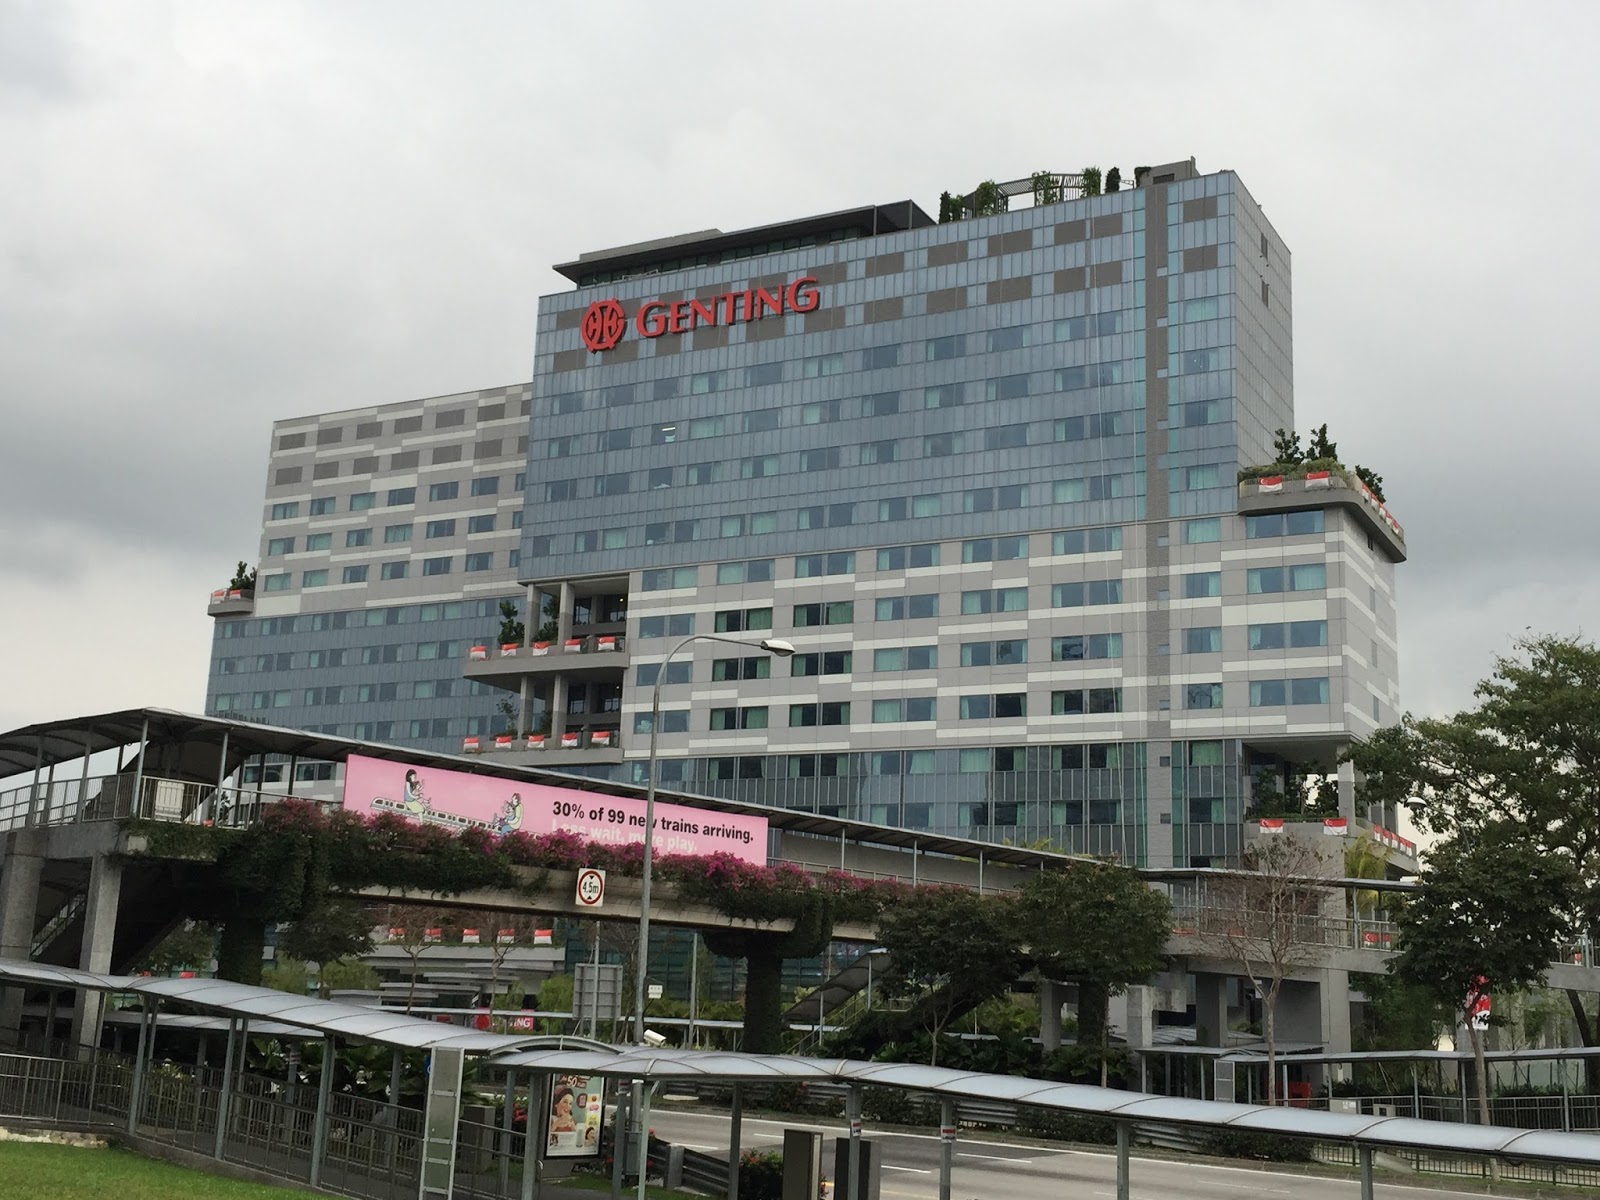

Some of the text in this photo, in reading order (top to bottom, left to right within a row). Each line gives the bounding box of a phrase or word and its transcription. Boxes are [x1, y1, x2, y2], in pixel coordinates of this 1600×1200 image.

[636, 276, 820, 338] GENTING
[552, 800, 585, 819] 30%
[589, 807, 604, 821] of
[608, 808, 625, 824] 99
[661, 817, 699, 834] trains
[702, 824, 754, 844] arriving.
[590, 826, 625, 844] wait,
[667, 835, 697, 854] play.
[582, 881, 599, 894] 4.5m
[566, 1075, 578, 1087] 50
